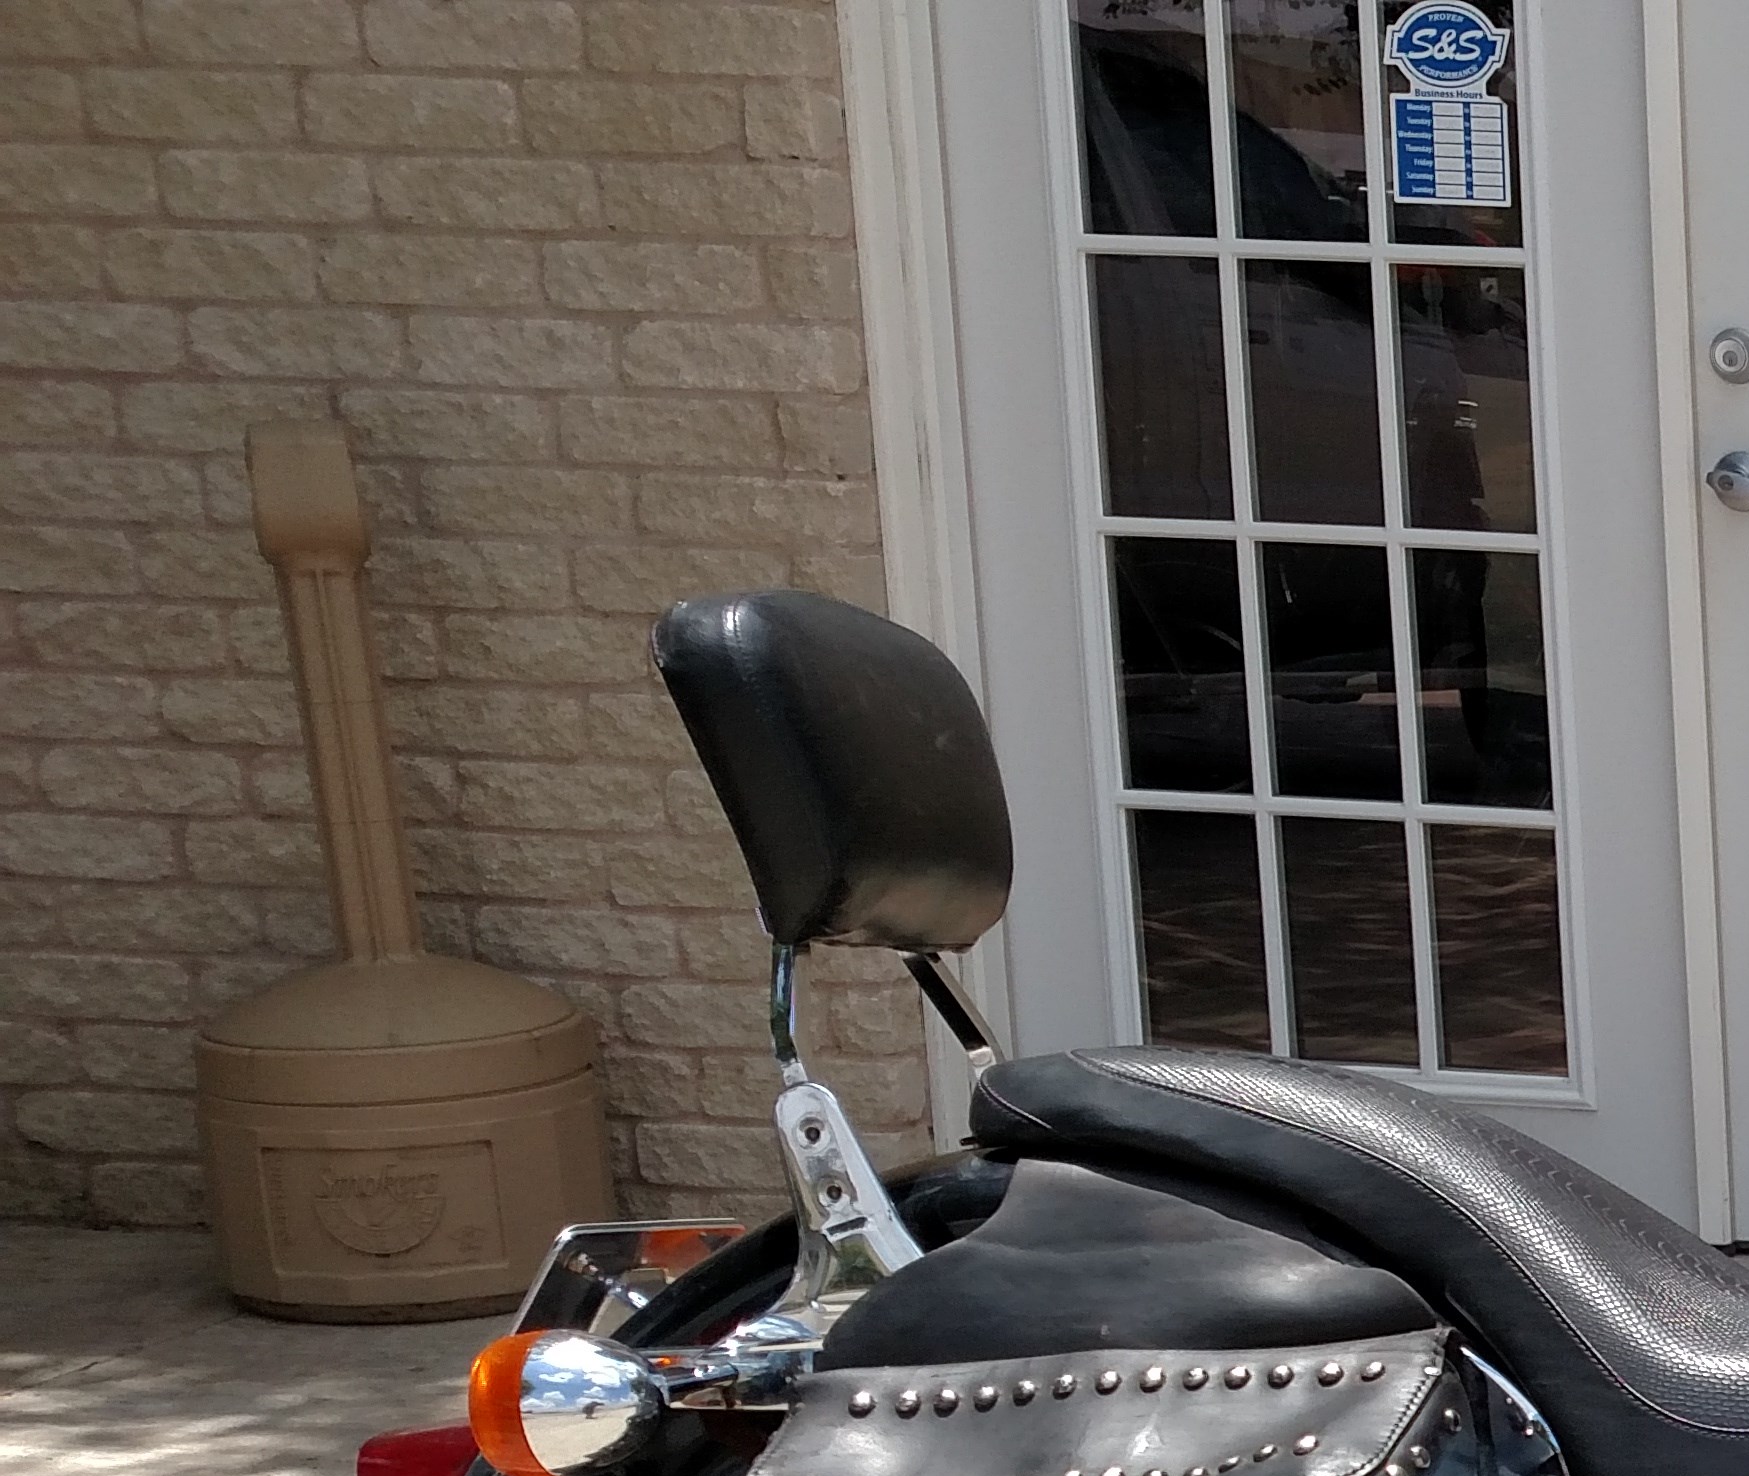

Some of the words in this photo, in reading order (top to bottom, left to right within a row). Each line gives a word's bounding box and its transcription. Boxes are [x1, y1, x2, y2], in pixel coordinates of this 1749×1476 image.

[1428, 13, 1465, 23] PROVEN
[1406, 28, 1486, 61] S&S
[1418, 64, 1479, 80] PERFORMANCE
[1414, 88, 1454, 98] Business
[1456, 90, 1483, 100] Hours
[1413, 158, 1433, 168] Friday
